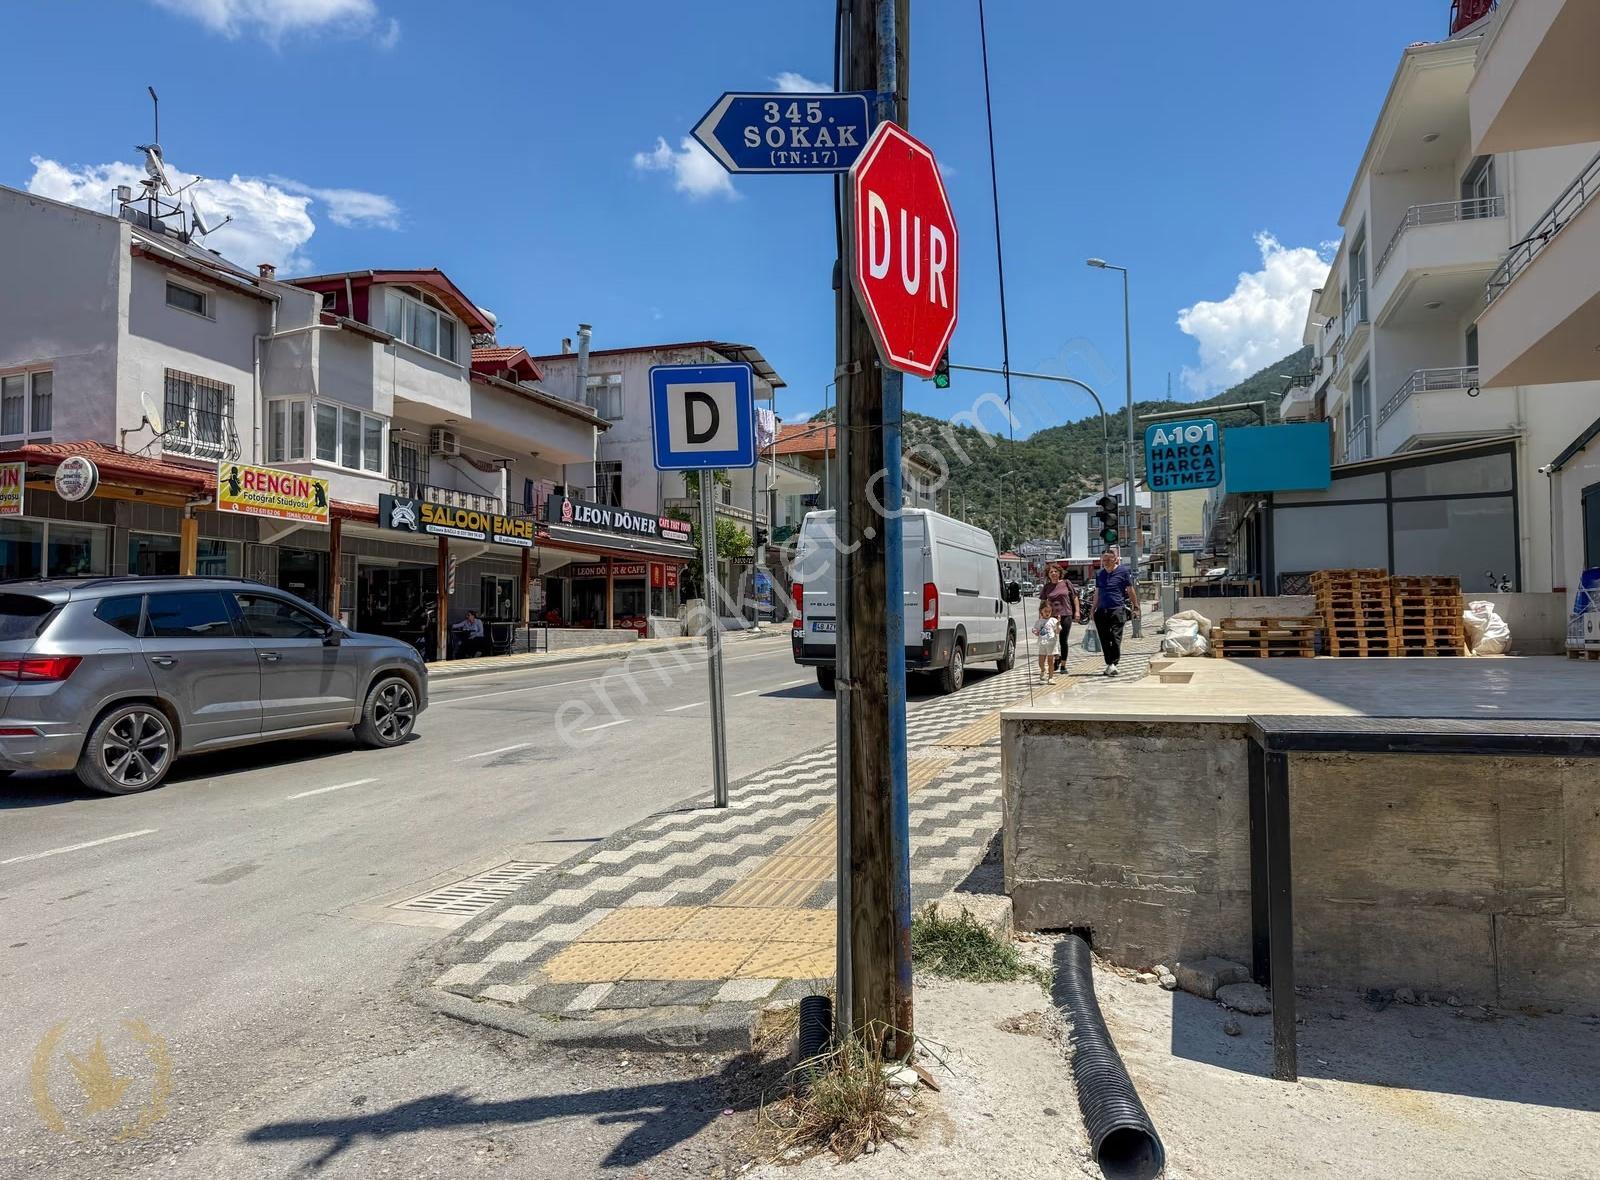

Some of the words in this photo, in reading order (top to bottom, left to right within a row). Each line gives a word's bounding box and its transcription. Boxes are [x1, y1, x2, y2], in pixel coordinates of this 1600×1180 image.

[764, 101, 835, 124] 345.
[743, 125, 859, 148] SOKAK
[770, 151, 839, 166] (TN:17)
[868, 189, 949, 309] DUR
[684, 391, 720, 444] D
[1152, 444, 1214, 460] HARCA
[1152, 458, 1215, 474] HARCA
[243, 470, 309, 498] RENGİN
[243, 491, 276, 504] Fotoğraf
[277, 496, 309, 509] Stüdyosu
[420, 503, 490, 532] SALOON
[493, 515, 533, 539] EMRE
[574, 505, 611, 526] LEON
[613, 511, 656, 534] DÖNER
[658, 518, 670, 528] CAFE
[577, 567, 595, 576] LEON
[627, 566, 645, 575] CAFE
